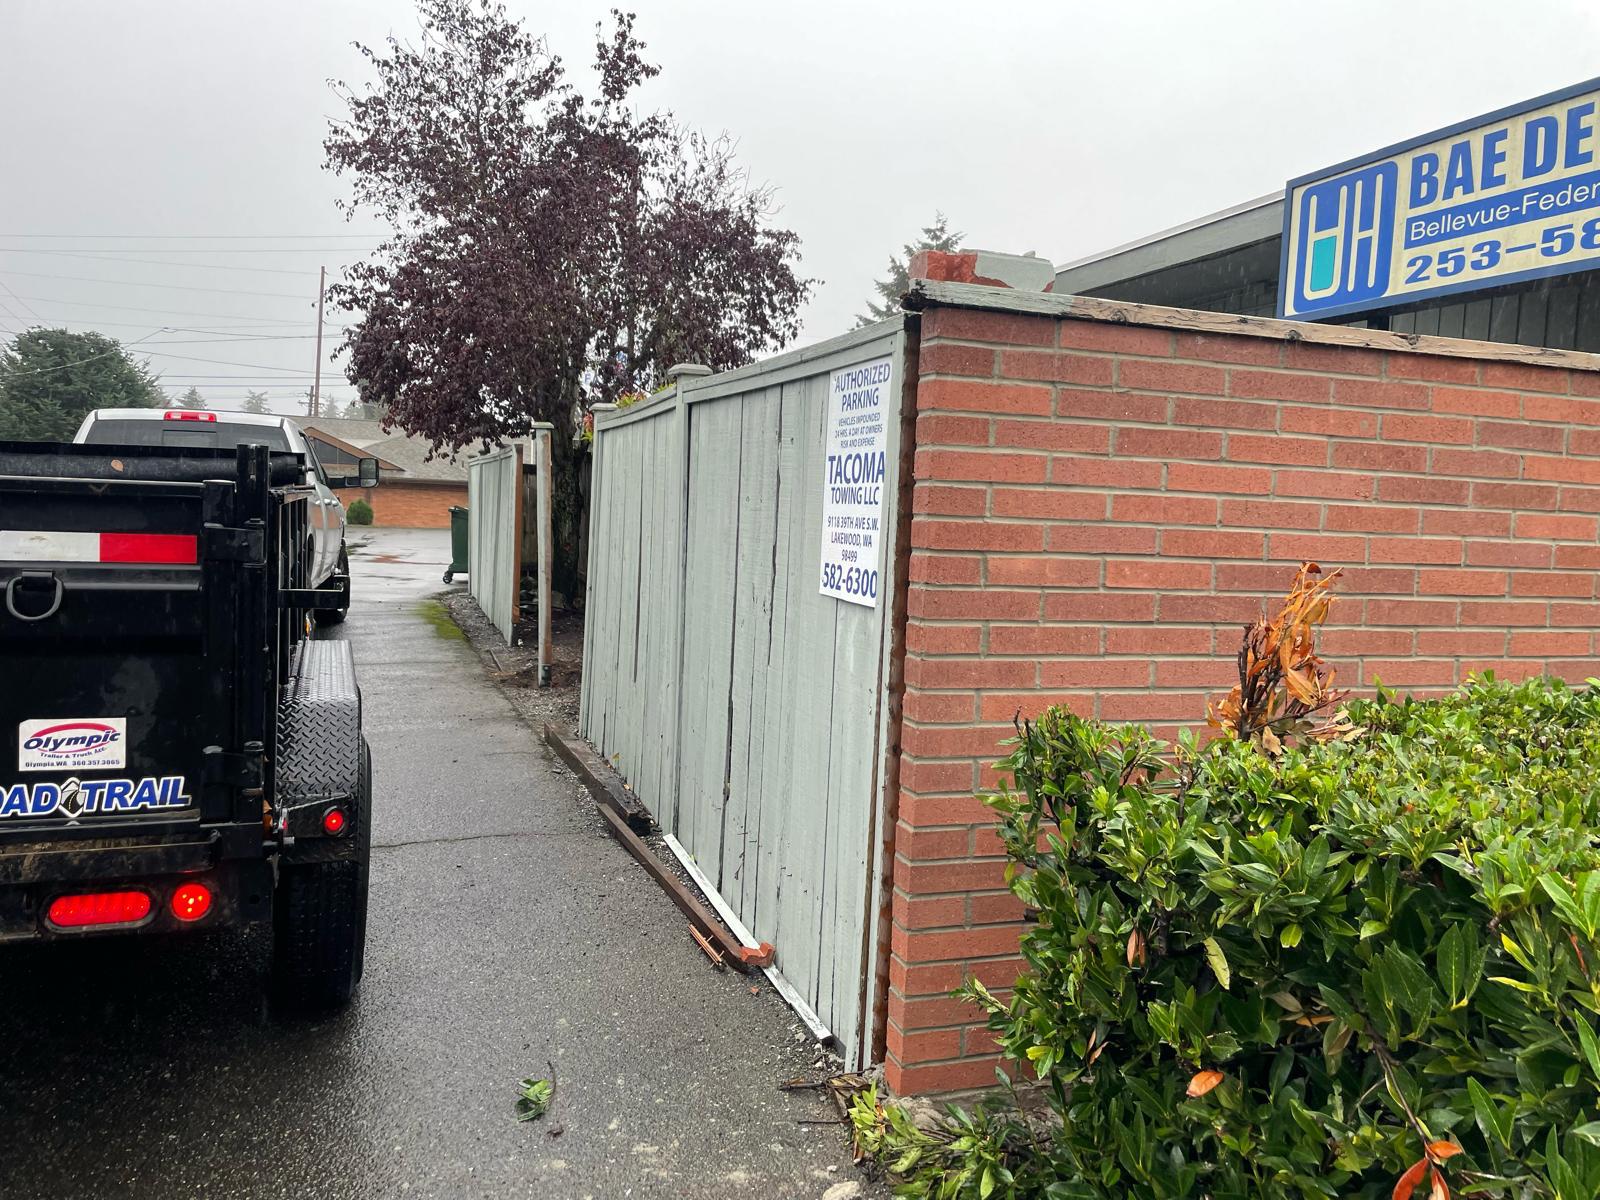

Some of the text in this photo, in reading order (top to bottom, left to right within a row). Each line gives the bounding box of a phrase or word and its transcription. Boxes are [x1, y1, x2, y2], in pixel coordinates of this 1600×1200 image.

[1409, 101, 1595, 210] BAE DE
[834, 363, 891, 393] AUTHORIZED
[841, 387, 880, 412] PARKING
[838, 412, 881, 427] VEHICLES IMPOUNDED
[860, 426, 866, 435] AT
[840, 436, 875, 448] RISK AND EXPENSE
[828, 451, 885, 485] TACOMA
[831, 486, 880, 505] TOWING LLC
[827, 515, 879, 531] 9118 39TH AVE S.W.
[831, 533, 872, 548] LAKEWOOD, WA
[841, 549, 858, 562] 98499
[822, 562, 878, 599] 582-6300
[23, 730, 121, 752] Olympic
[0, 776, 192, 817] AD TRAIL
